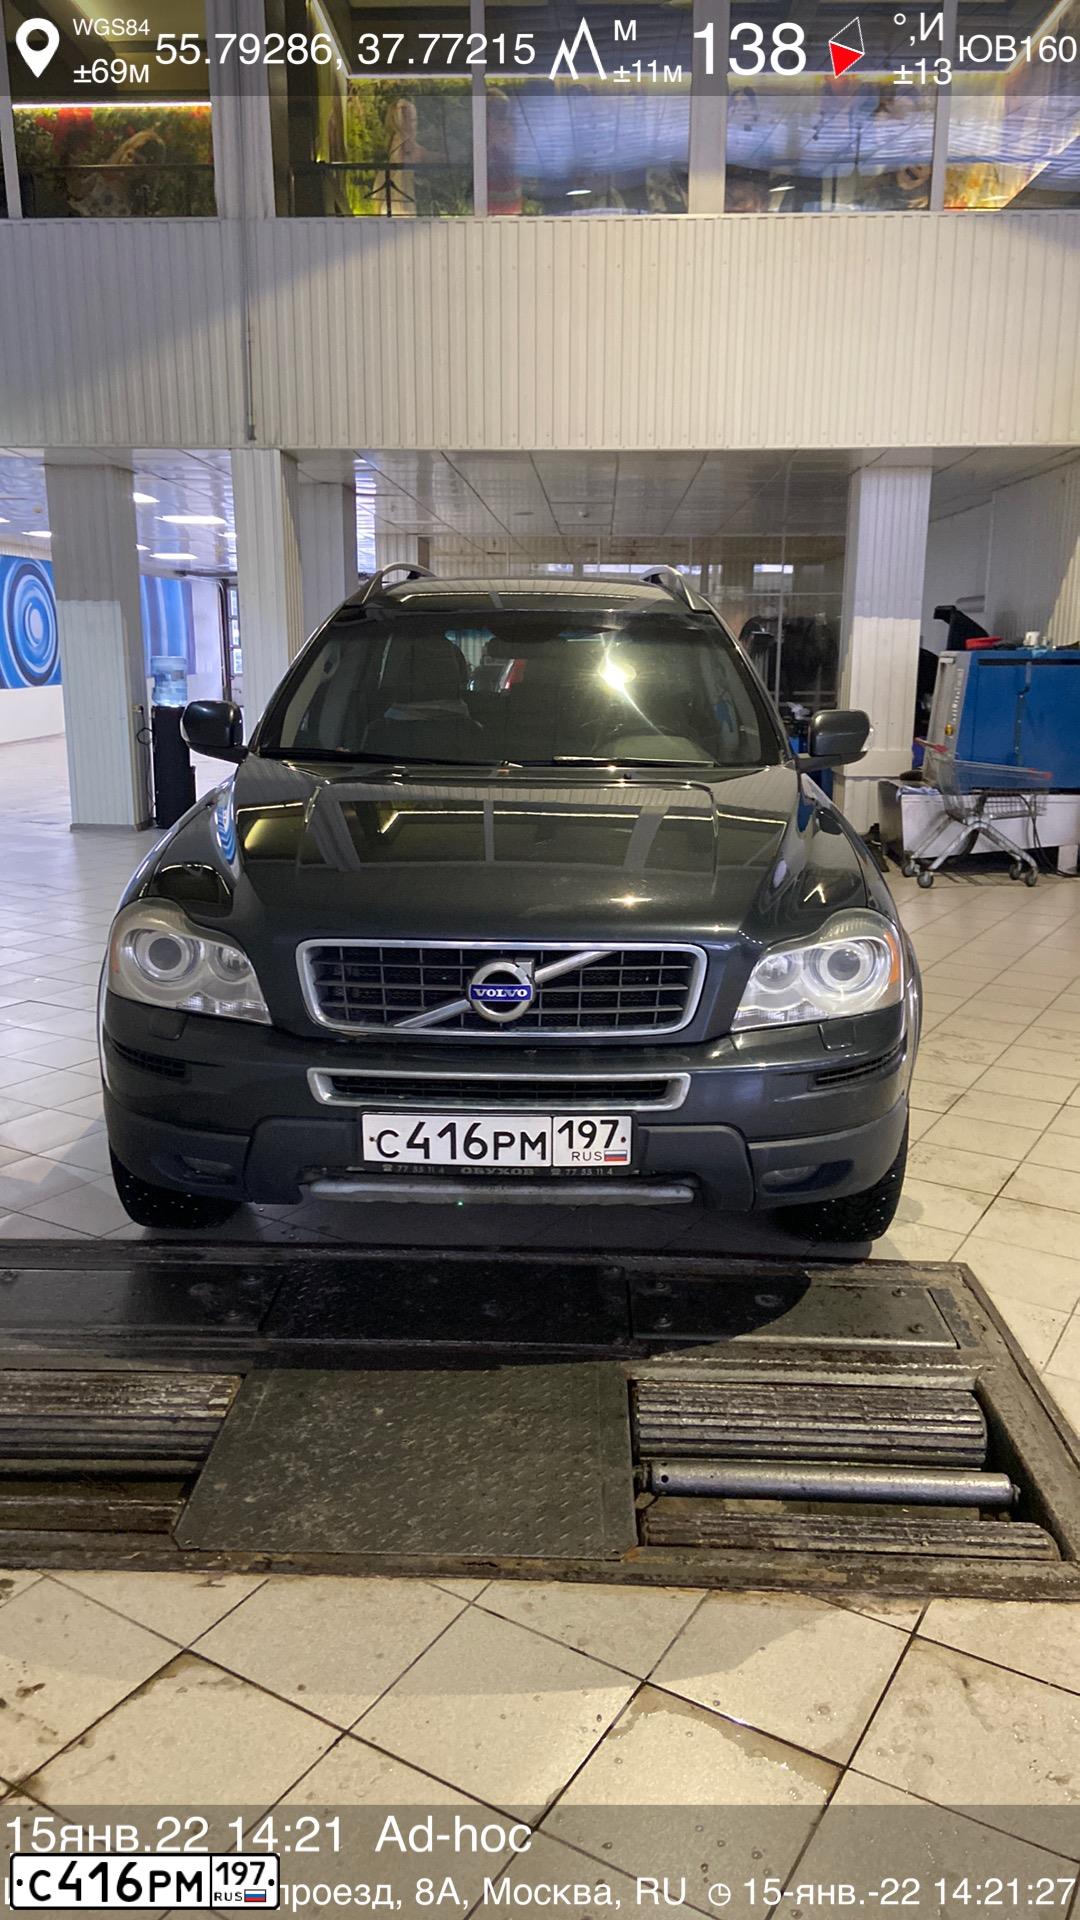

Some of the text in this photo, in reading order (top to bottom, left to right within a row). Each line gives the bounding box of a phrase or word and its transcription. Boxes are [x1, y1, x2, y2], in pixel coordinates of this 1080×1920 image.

[473, 988, 528, 998] VOLVO
[376, 1119, 619, 1160] С416РМ 197
[571, 1151, 603, 1162] RUS
